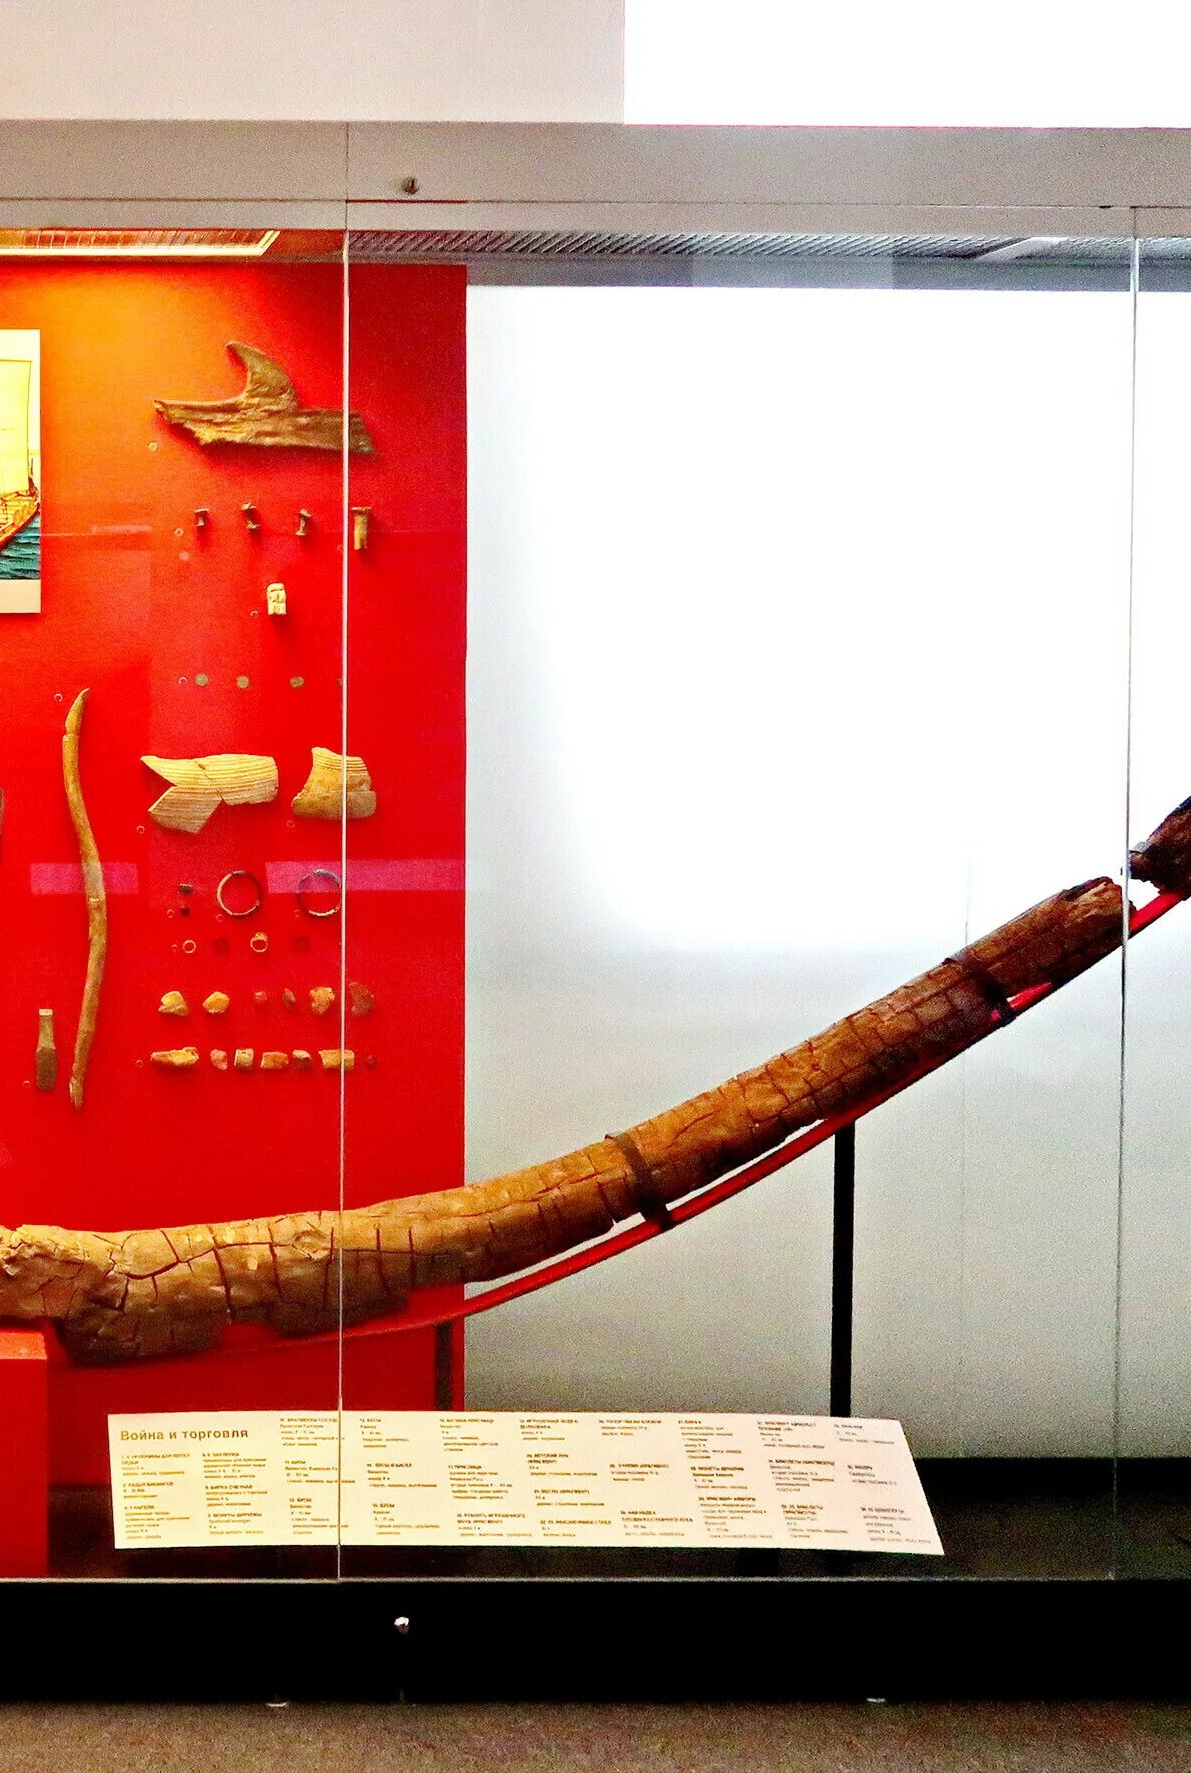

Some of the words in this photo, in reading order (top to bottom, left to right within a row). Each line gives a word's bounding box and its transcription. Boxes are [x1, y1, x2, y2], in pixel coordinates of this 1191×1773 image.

[120, 1429, 164, 1440] Война
[169, 1432, 177, 1440] и
[182, 1429, 249, 1441] торговля
